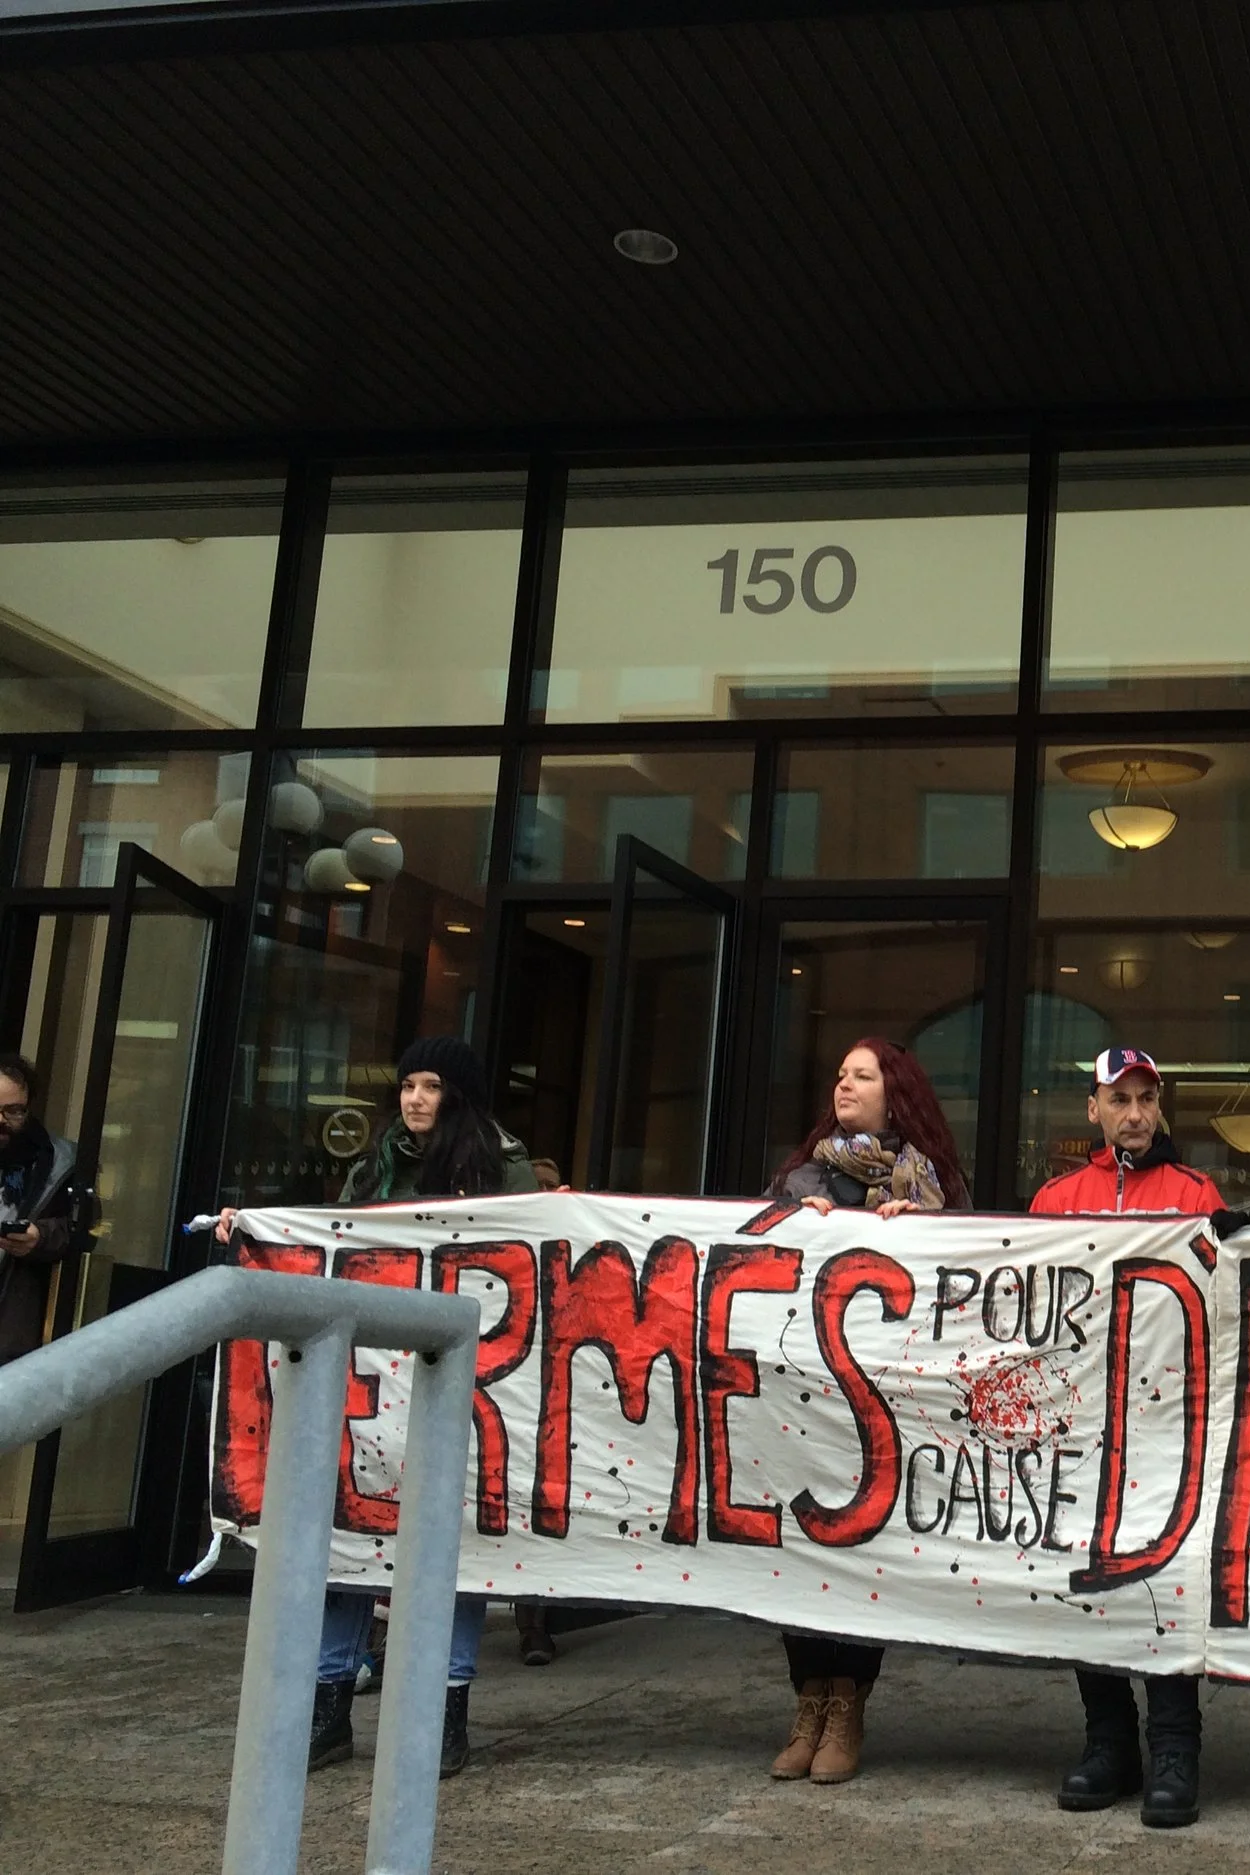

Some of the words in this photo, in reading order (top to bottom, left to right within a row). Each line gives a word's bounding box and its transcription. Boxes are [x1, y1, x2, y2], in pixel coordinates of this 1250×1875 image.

[707, 545, 857, 615] 150
[930, 1265, 1094, 1347] POUR
[905, 1443, 1083, 1553] CAUSE
